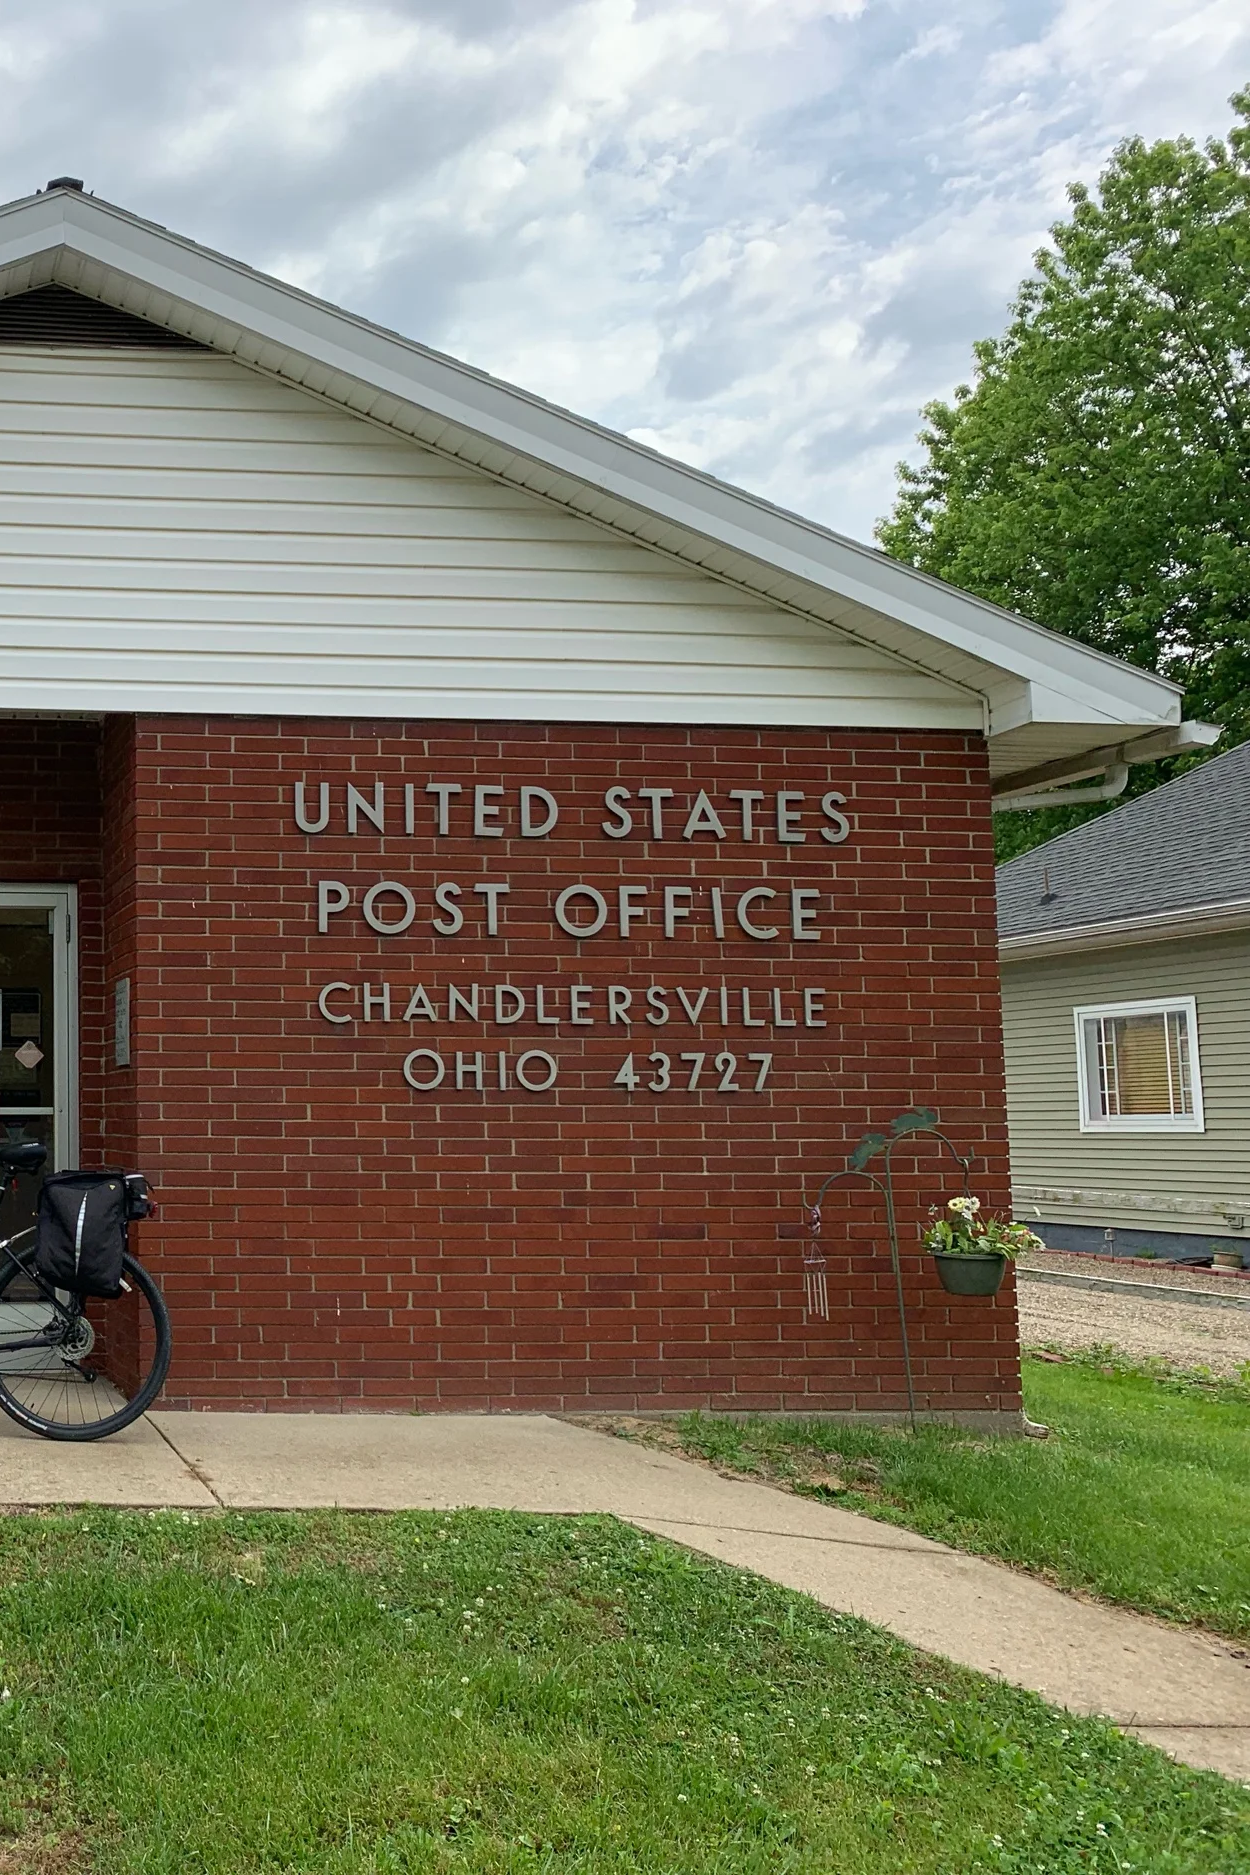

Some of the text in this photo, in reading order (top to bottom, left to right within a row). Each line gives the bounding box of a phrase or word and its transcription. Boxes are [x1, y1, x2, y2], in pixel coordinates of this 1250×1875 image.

[294, 781, 851, 844] UNITED STATES
[317, 880, 822, 940] POST OFFICE
[318, 981, 828, 1027] CHANDLERSVILLE
[402, 1047, 773, 1092] OHIO 43727
